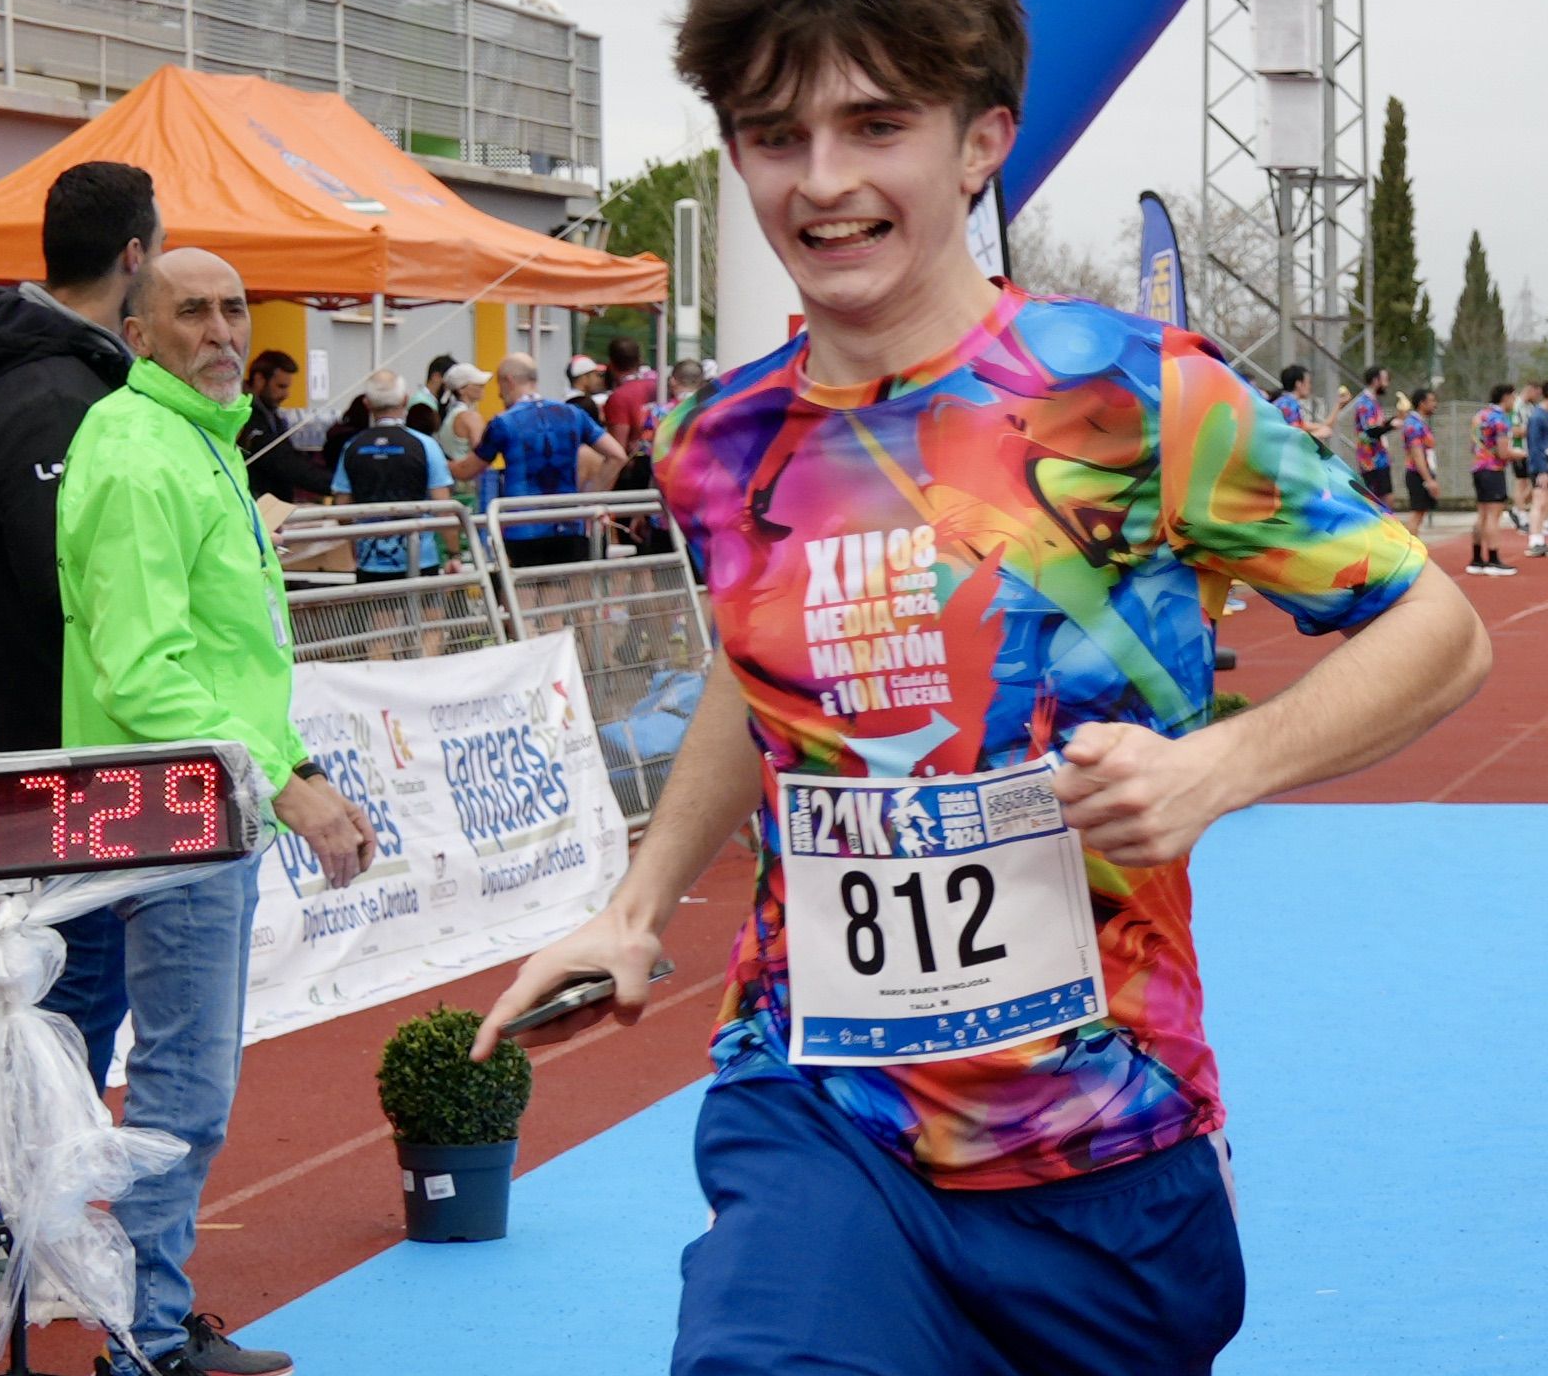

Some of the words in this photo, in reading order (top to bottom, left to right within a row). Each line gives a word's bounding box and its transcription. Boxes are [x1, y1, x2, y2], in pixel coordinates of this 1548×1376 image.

[804, 530, 888, 608] XII
[887, 524, 938, 572] 08
[803, 600, 896, 643] MEDIA
[892, 593, 940, 618] 2026
[808, 624, 947, 680] MARATÓN
[833, 675, 892, 715] 10K
[440, 723, 547, 789] carreras
[810, 789, 893, 856] 21K
[943, 825, 985, 851] 2026
[838, 862, 1008, 978] 812
